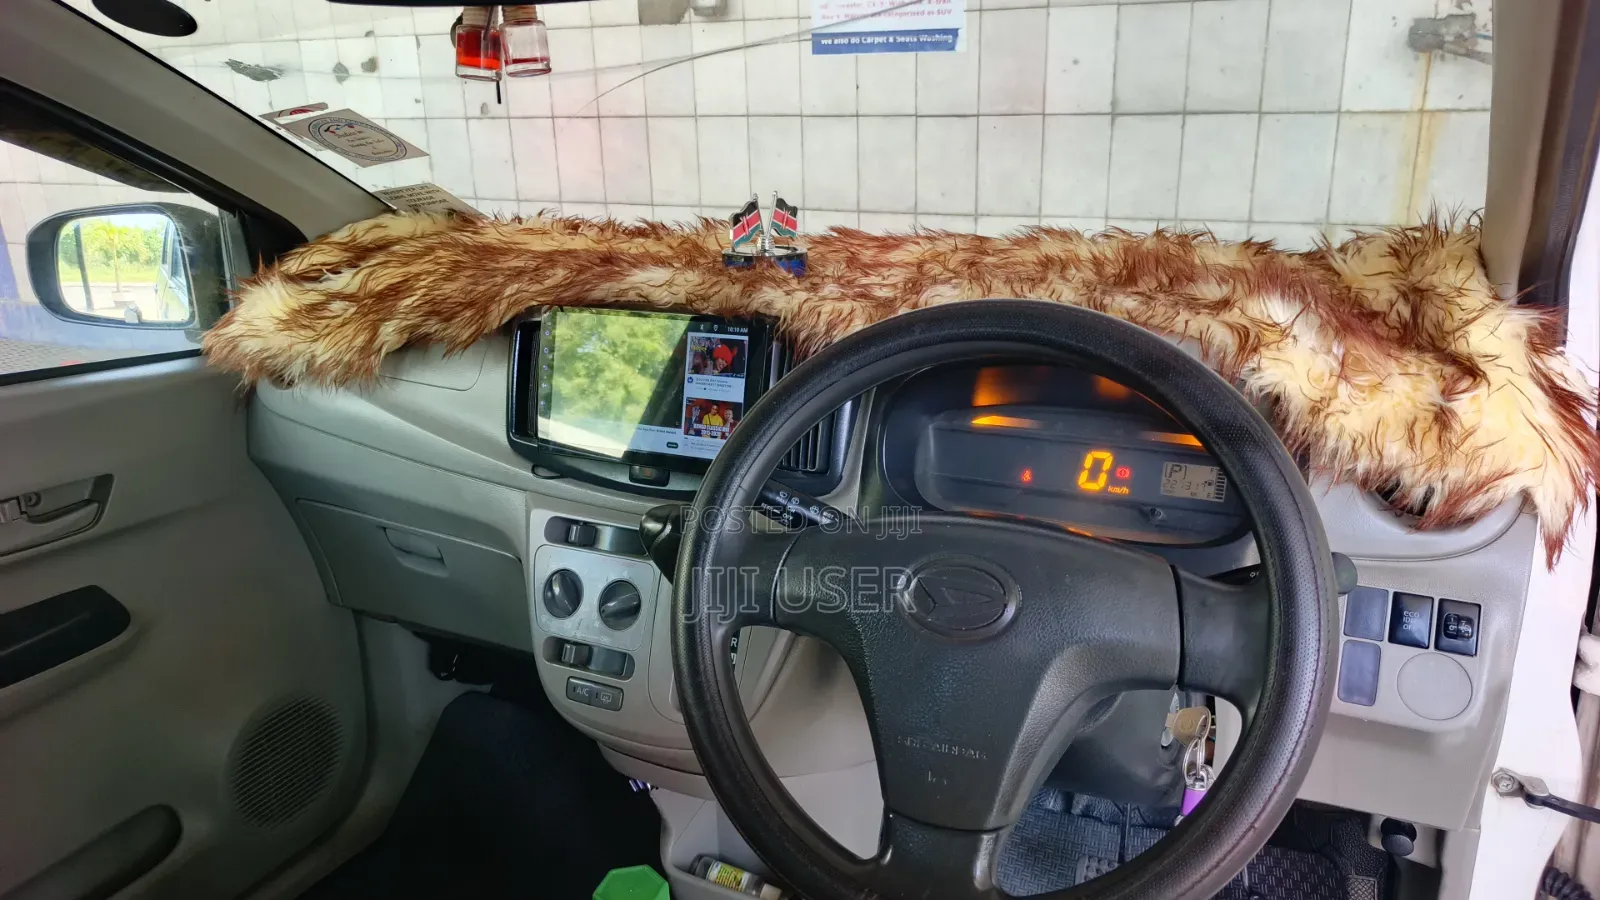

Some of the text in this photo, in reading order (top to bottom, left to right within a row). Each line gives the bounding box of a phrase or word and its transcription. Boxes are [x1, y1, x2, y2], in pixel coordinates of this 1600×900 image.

[850, 36, 860, 44] do
[861, 35, 887, 45] Carpet
[1077, 450, 1114, 491] 0
[1107, 485, 1130, 495] km/h
[576, 687, 590, 697] A/C
